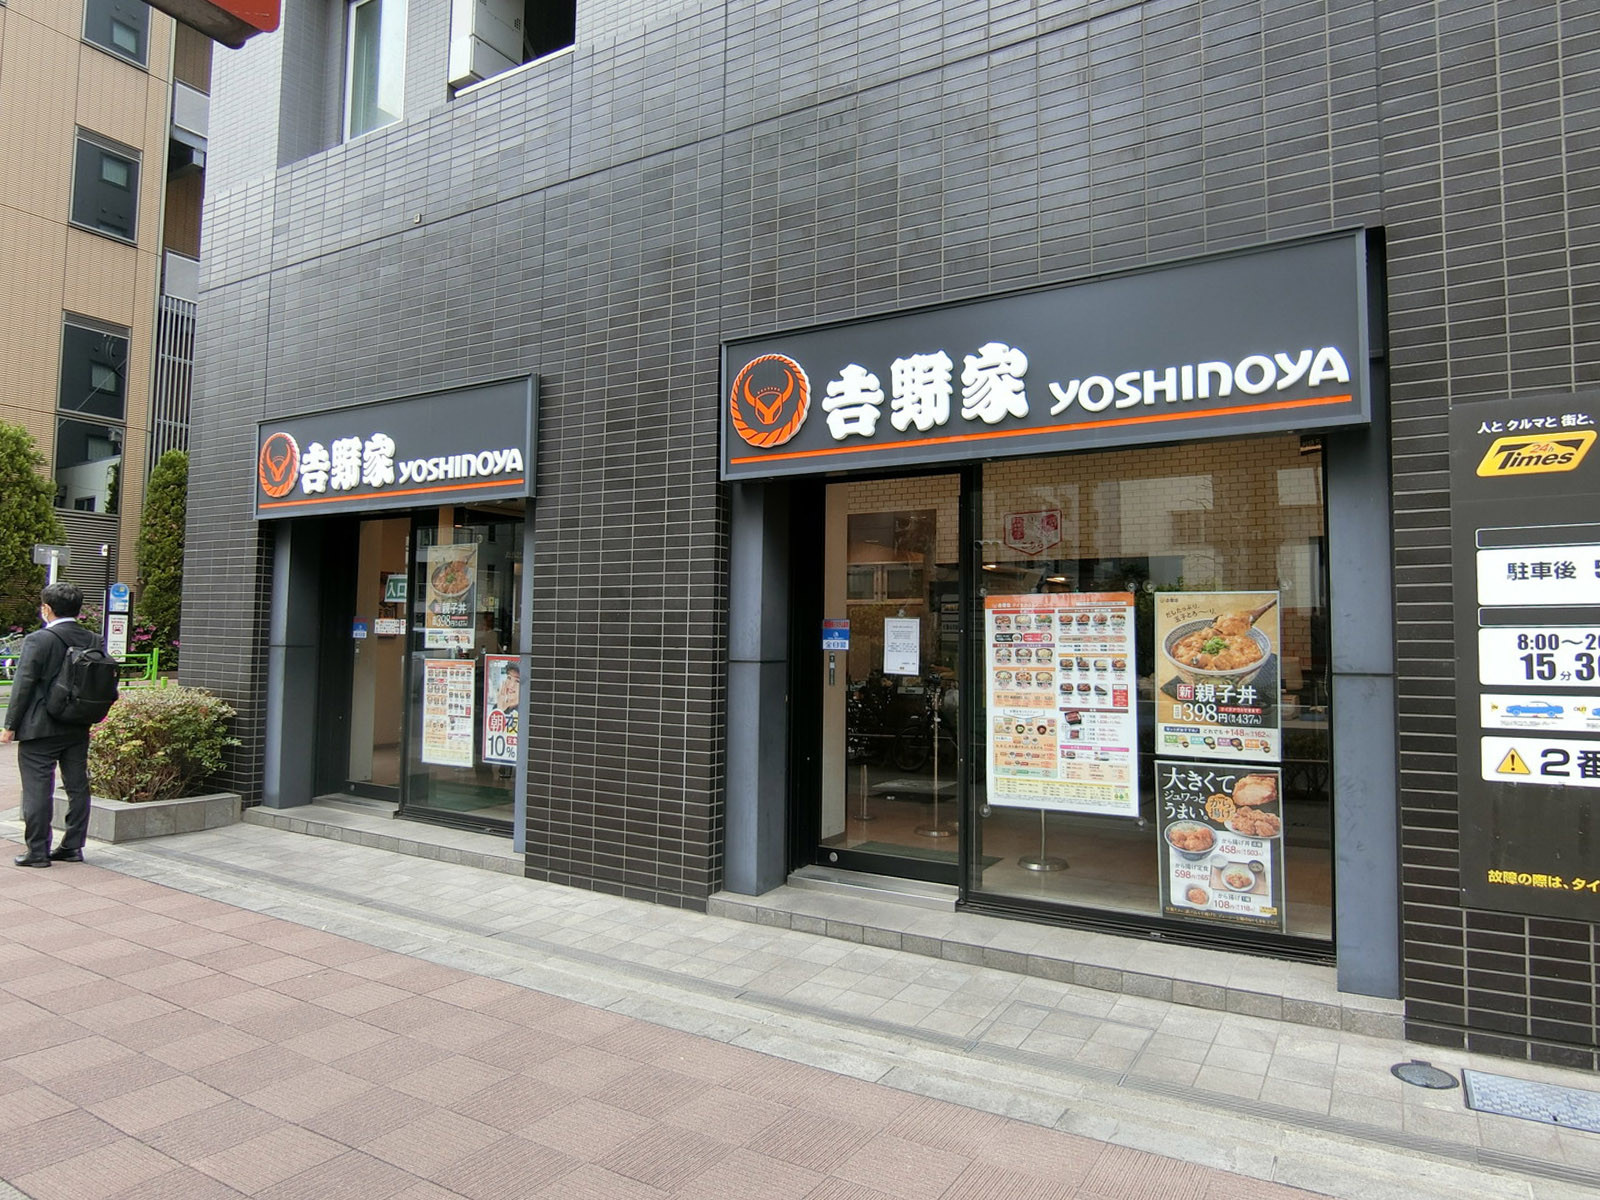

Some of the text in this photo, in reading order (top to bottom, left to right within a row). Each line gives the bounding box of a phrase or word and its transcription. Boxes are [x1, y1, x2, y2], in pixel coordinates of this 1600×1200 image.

[822, 342, 1031, 441] 吉野家
[1048, 346, 1352, 417] YOSHINOYA
[1477, 421, 1503, 434] 人と
[1507, 416, 1557, 431] クルマと
[300, 433, 396, 494] 吉野家
[399, 448, 524, 485] YOSHINOYA
[1497, 451, 1575, 470] Times
[1507, 561, 1577, 581] 駐車後
[387, 583, 407, 598] 入口
[1517, 633, 1600, 650] 8:00〜2
[1179, 683, 1257, 705] 新 親子丼
[1163, 767, 1235, 793] 大きくて
[1164, 790, 1206, 804] ジュワっと
[1164, 802, 1209, 820] うまい。
